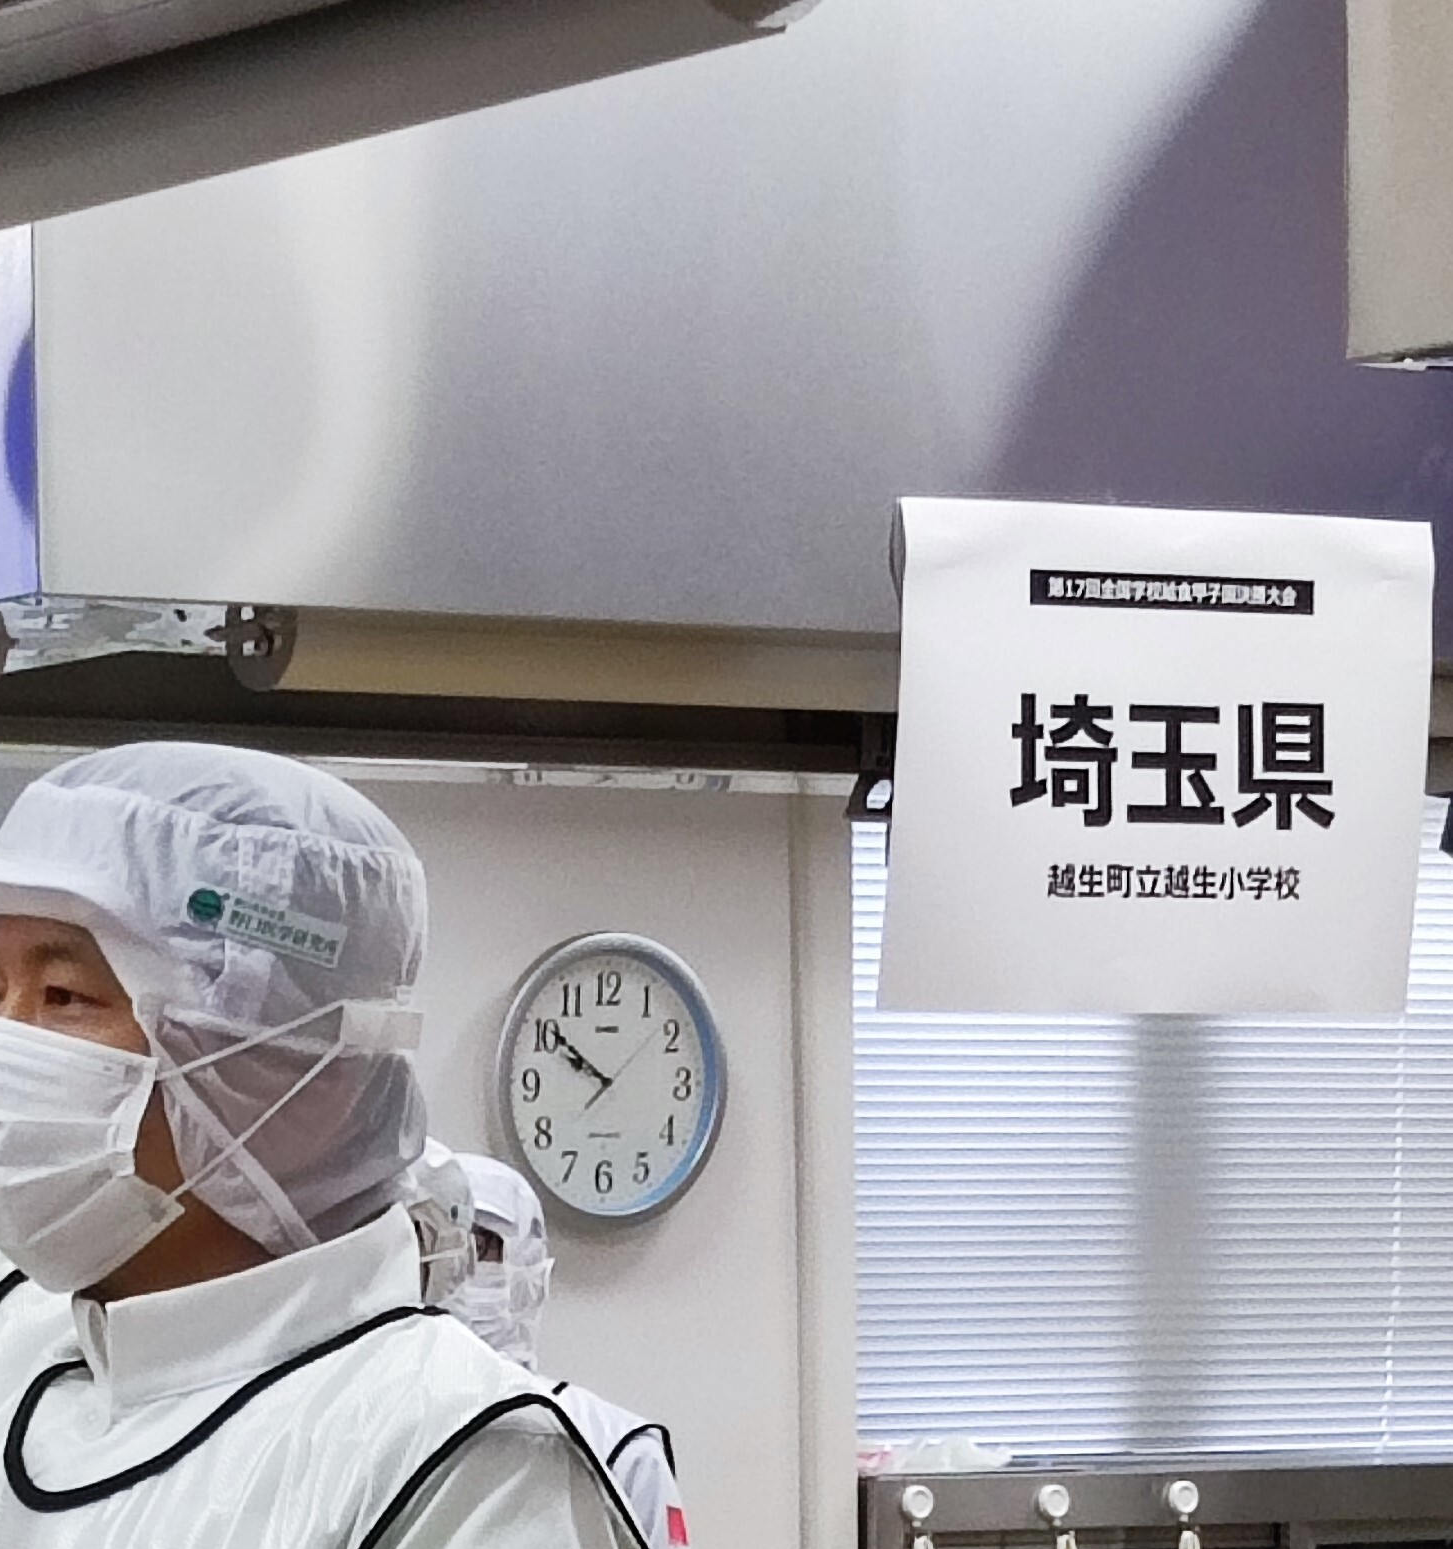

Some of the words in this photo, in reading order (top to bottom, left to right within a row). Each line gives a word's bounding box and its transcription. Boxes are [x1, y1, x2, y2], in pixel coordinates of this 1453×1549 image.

[1010, 693, 1336, 831] 埼玉県
[1047, 864, 1301, 901] 越生町立越生小学校
[560, 983, 583, 1018] 11
[595, 970, 622, 1006] 12
[641, 985, 651, 1018] 1
[533, 1018, 560, 1054] 10
[663, 1019, 680, 1053] 2
[521, 1068, 541, 1103] 9
[672, 1066, 692, 1101] 3
[533, 1116, 553, 1150] 8
[659, 1114, 675, 1146] 4
[561, 1150, 578, 1183] 7
[595, 1160, 613, 1194] 6
[632, 1152, 650, 1184] 5
